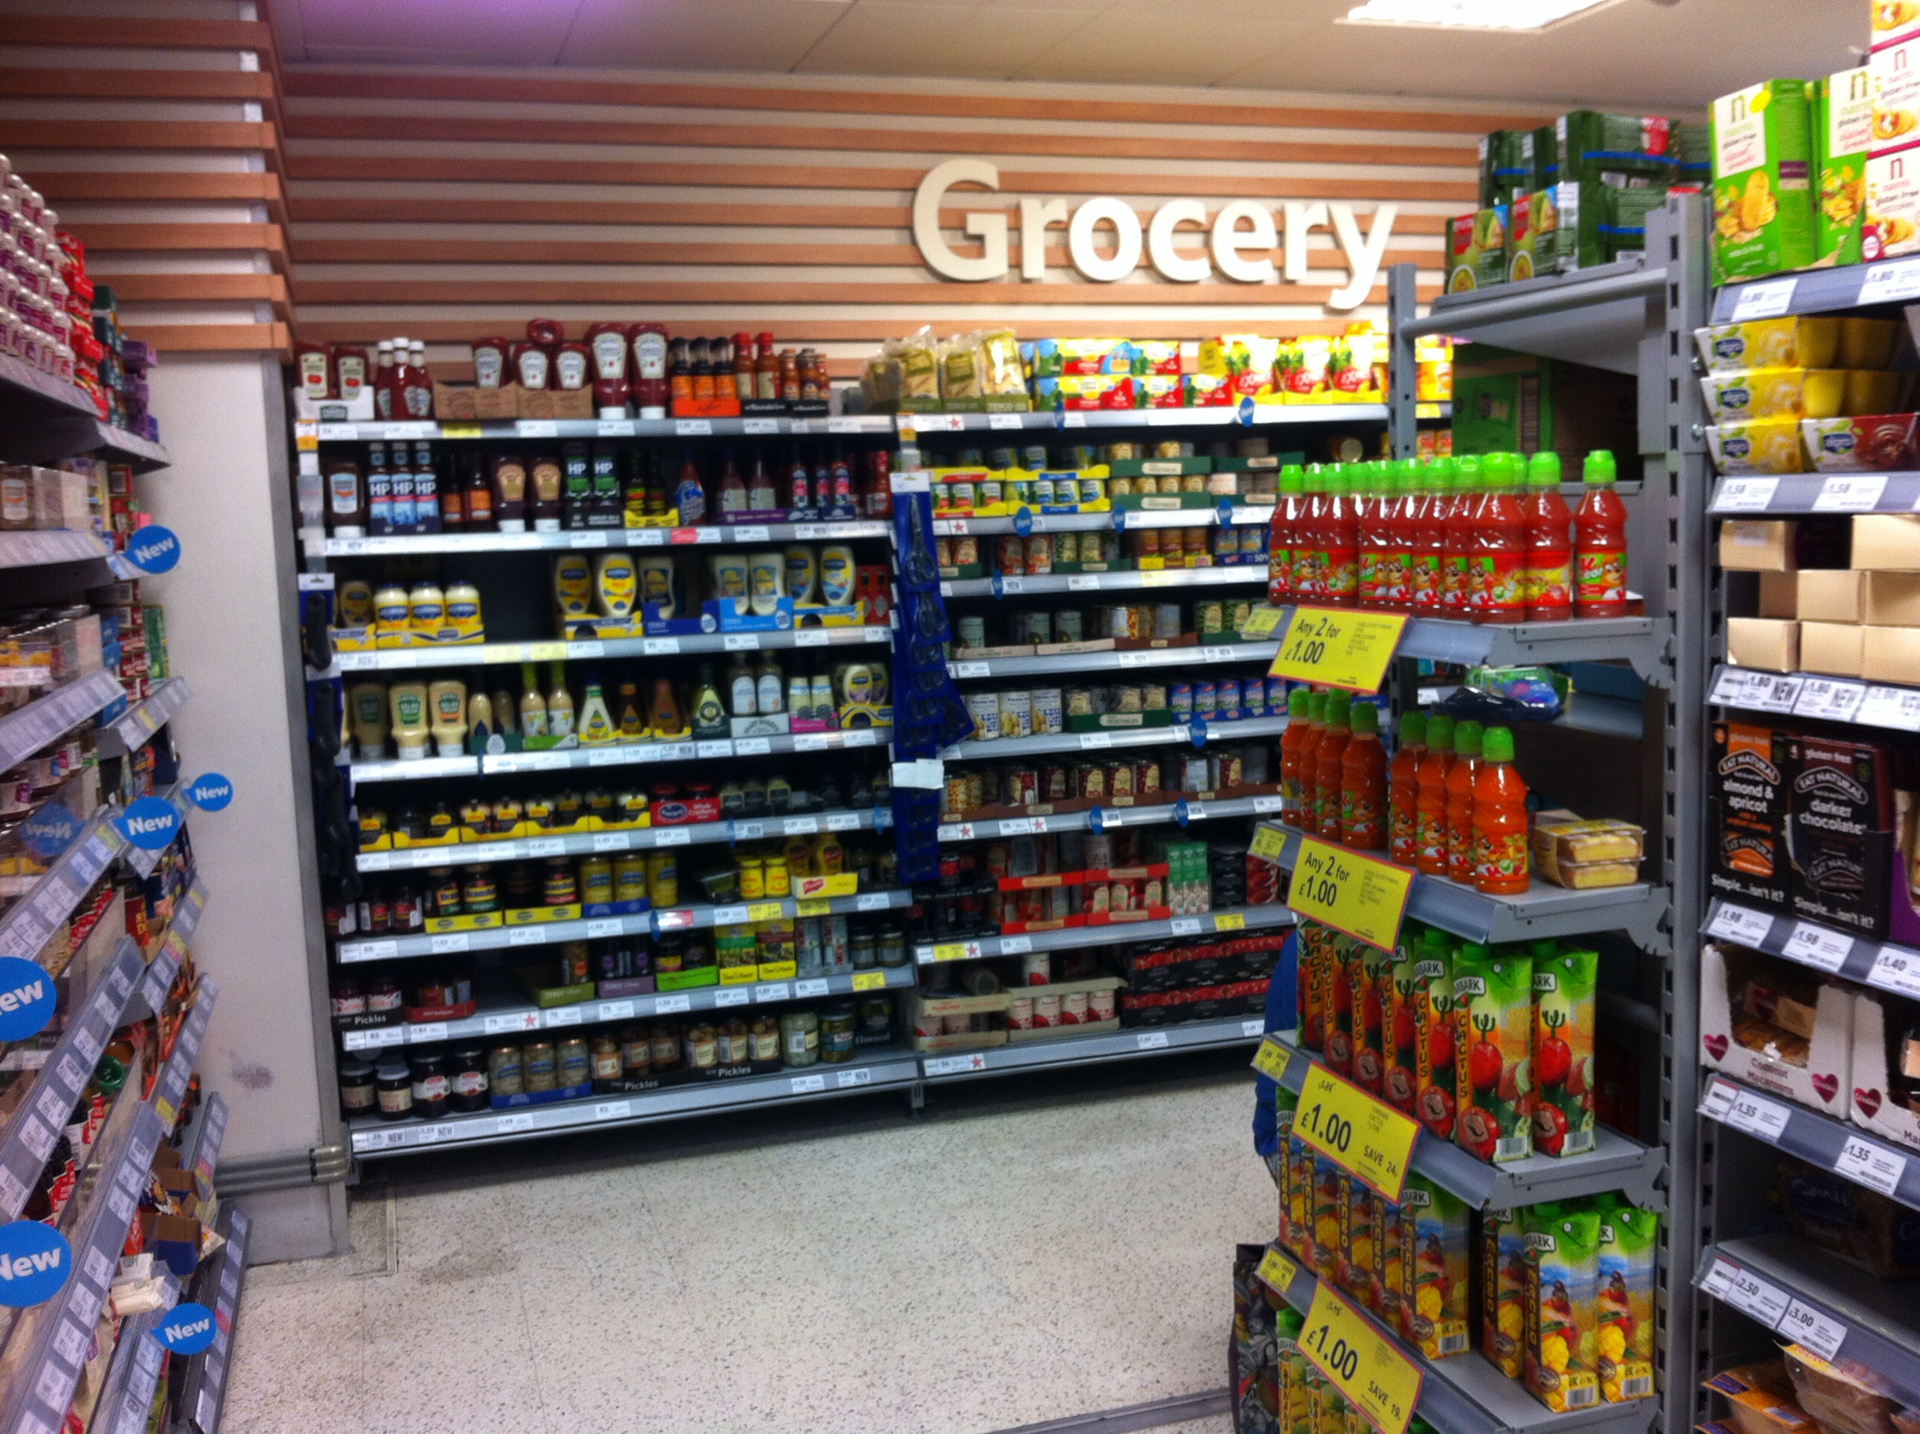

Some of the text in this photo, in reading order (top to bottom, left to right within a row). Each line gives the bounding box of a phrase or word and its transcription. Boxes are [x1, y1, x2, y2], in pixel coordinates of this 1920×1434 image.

[912, 158, 1398, 309] Grocery
[370, 482, 390, 496] HP
[393, 481, 413, 495] HP
[416, 481, 436, 495] HP
[136, 537, 174, 564] New
[1296, 617, 1341, 638] Any 2 for
[195, 785, 229, 801] New
[1723, 780, 1774, 799] almond &
[1728, 796, 1768, 813] apricot
[1809, 800, 1852, 817] darker
[127, 813, 173, 836] New
[1304, 852, 1350, 882] Any 2 for
[1299, 875, 1338, 907] £1.00
[1309, 931, 1322, 1004] CACTUS
[0, 979, 43, 1012] ew
[1325, 949, 1333, 1024] CACTUS
[1354, 964, 1363, 1041] CACTUS
[354, 1014, 387, 1026] Pickles
[1384, 979, 1394, 1060] CACTUS
[1418, 996, 1429, 1078] CACTUS
[1458, 1014, 1468, 1099] CACTUS
[718, 1066, 751, 1077] Pickles
[624, 1080, 659, 1091] Pickles
[1300, 1103, 1352, 1153] £1.00
[1363, 1145, 1384, 1167] SAVE
[164, 1318, 210, 1342] New
[1306, 1324, 1358, 1381] £1.00
[1367, 1380, 1390, 1406] SAVE
